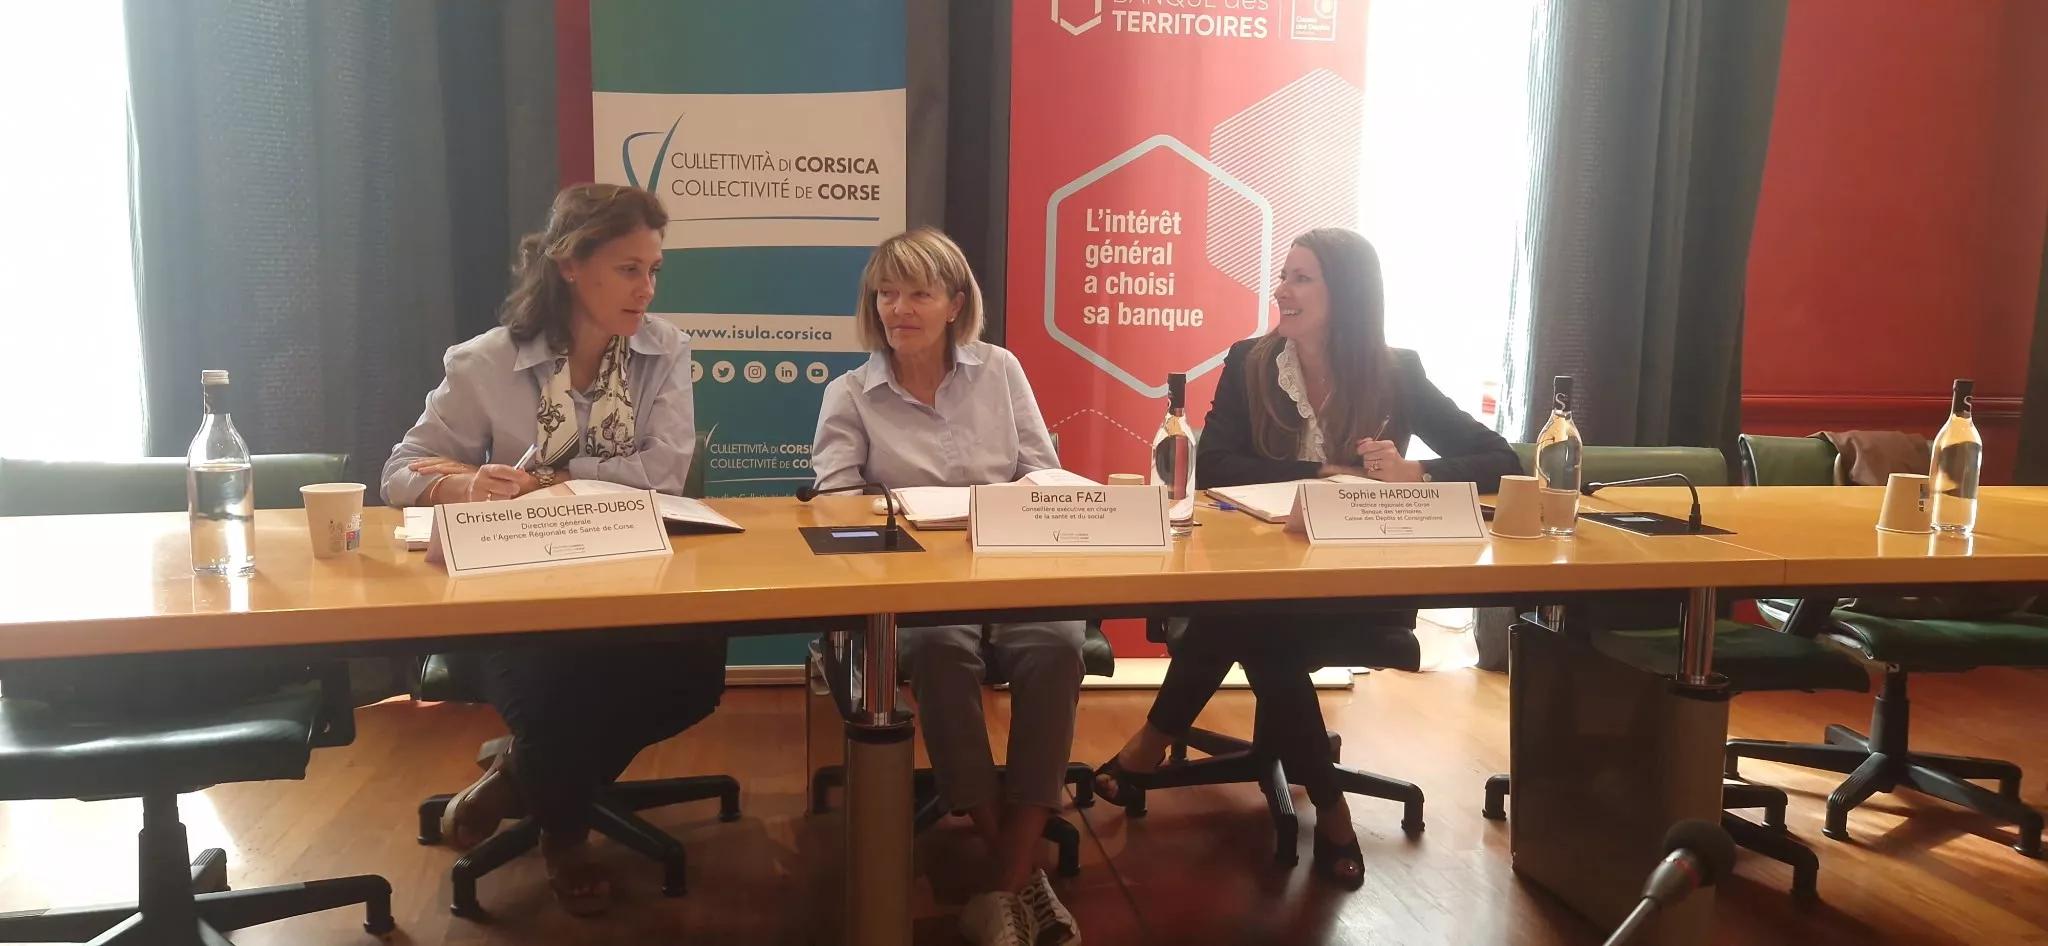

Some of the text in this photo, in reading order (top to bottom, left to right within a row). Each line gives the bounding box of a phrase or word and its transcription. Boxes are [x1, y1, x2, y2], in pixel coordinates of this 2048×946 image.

[1112, 10, 1268, 39] TERRITOIRES
[671, 150, 880, 175] CULLETTIVITÀ DI CORSICA
[671, 178, 880, 201] COLLECTIVITÉ DE CORSE
[1086, 208, 1182, 235] L'intérêt
[1085, 240, 1173, 268] général
[1084, 272, 1175, 296] a choisi
[1083, 302, 1204, 331] sa banque
[710, 442, 770, 454] CULLETTIVITÀ
[780, 444, 814, 454] CORSI
[710, 457, 778, 469] COLLECTIVITÉ
[1031, 491, 1107, 503] Bianca FAZI
[1338, 489, 1440, 501] Sophie HARDOUIN
[456, 499, 645, 524] Christelle BOUCHER-DUBOS
[494, 532, 527, 542] l'Agence
[521, 521, 558, 530] Directrice
